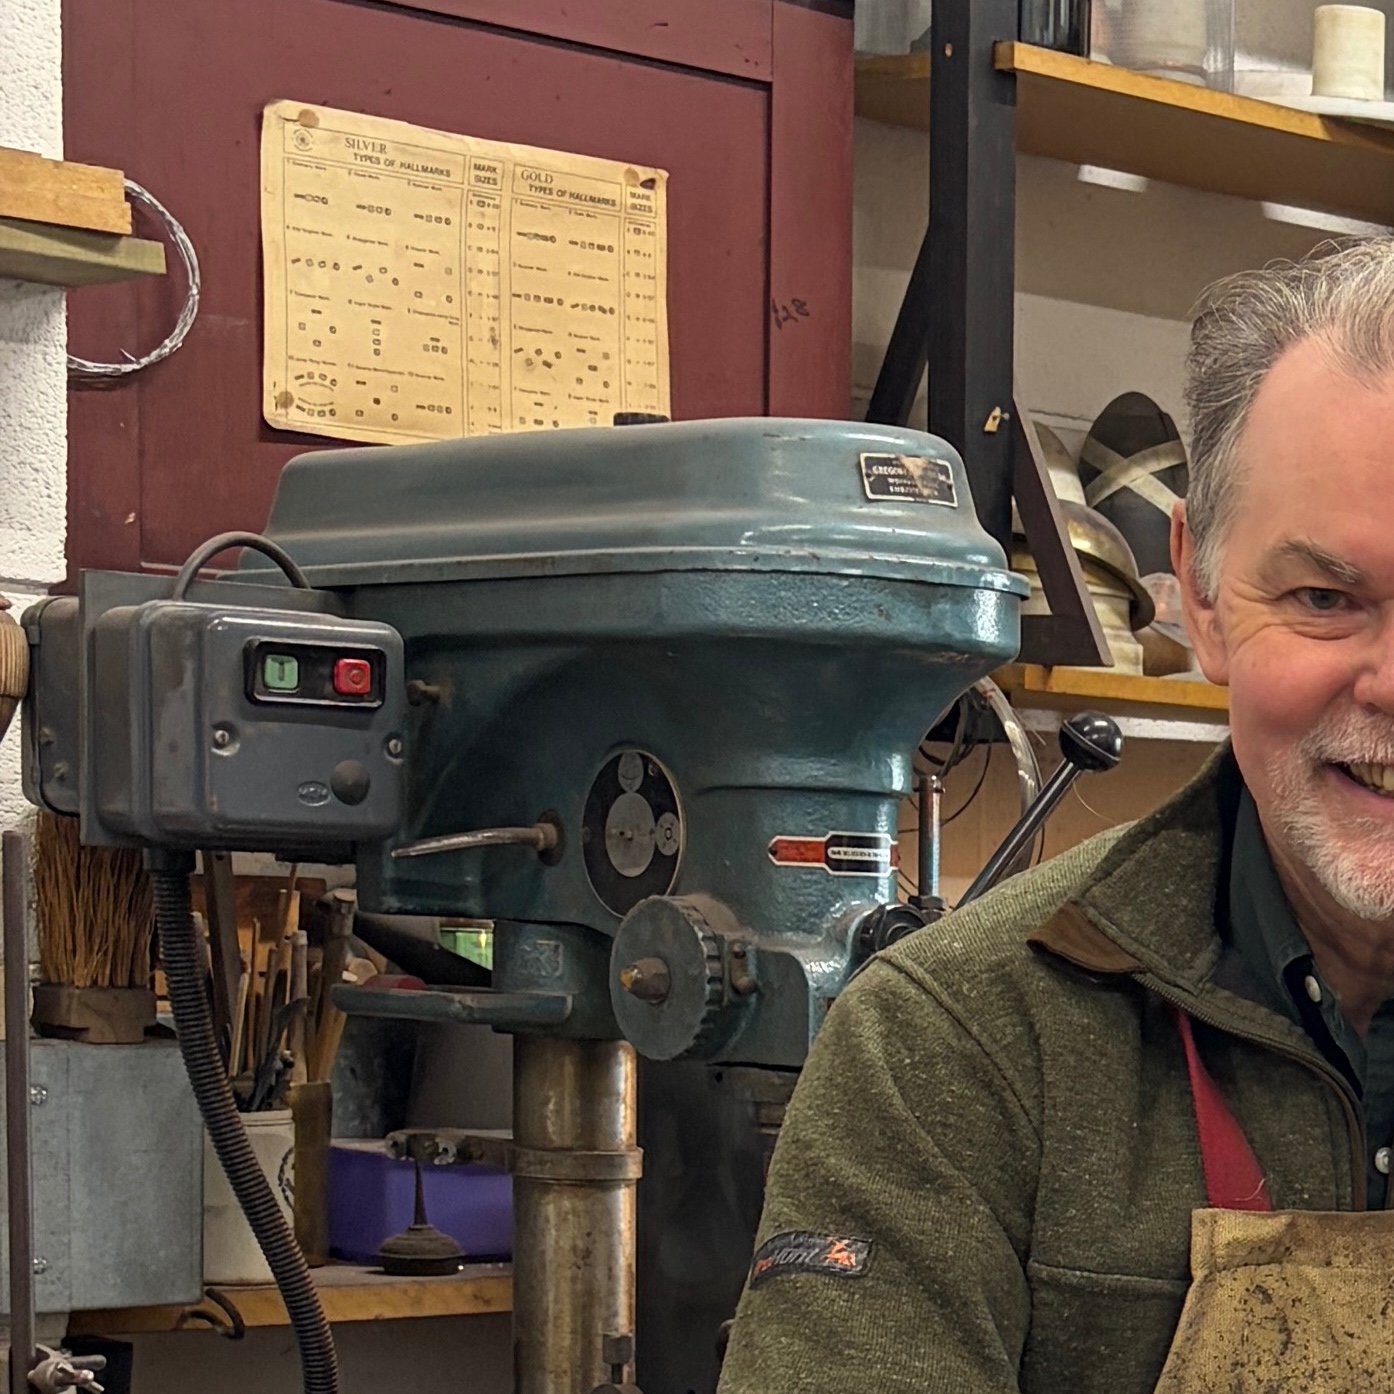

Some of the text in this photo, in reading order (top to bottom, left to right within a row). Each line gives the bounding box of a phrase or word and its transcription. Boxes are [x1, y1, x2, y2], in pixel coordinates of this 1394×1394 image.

[345, 137, 388, 154] SILVER
[353, 153, 451, 178] TYPES OF HALLMARKS
[473, 162, 499, 175] MARK
[474, 174, 499, 186] SIZES
[521, 169, 554, 184] GOLD
[528, 184, 617, 207] TYPES OF HALLMARKS
